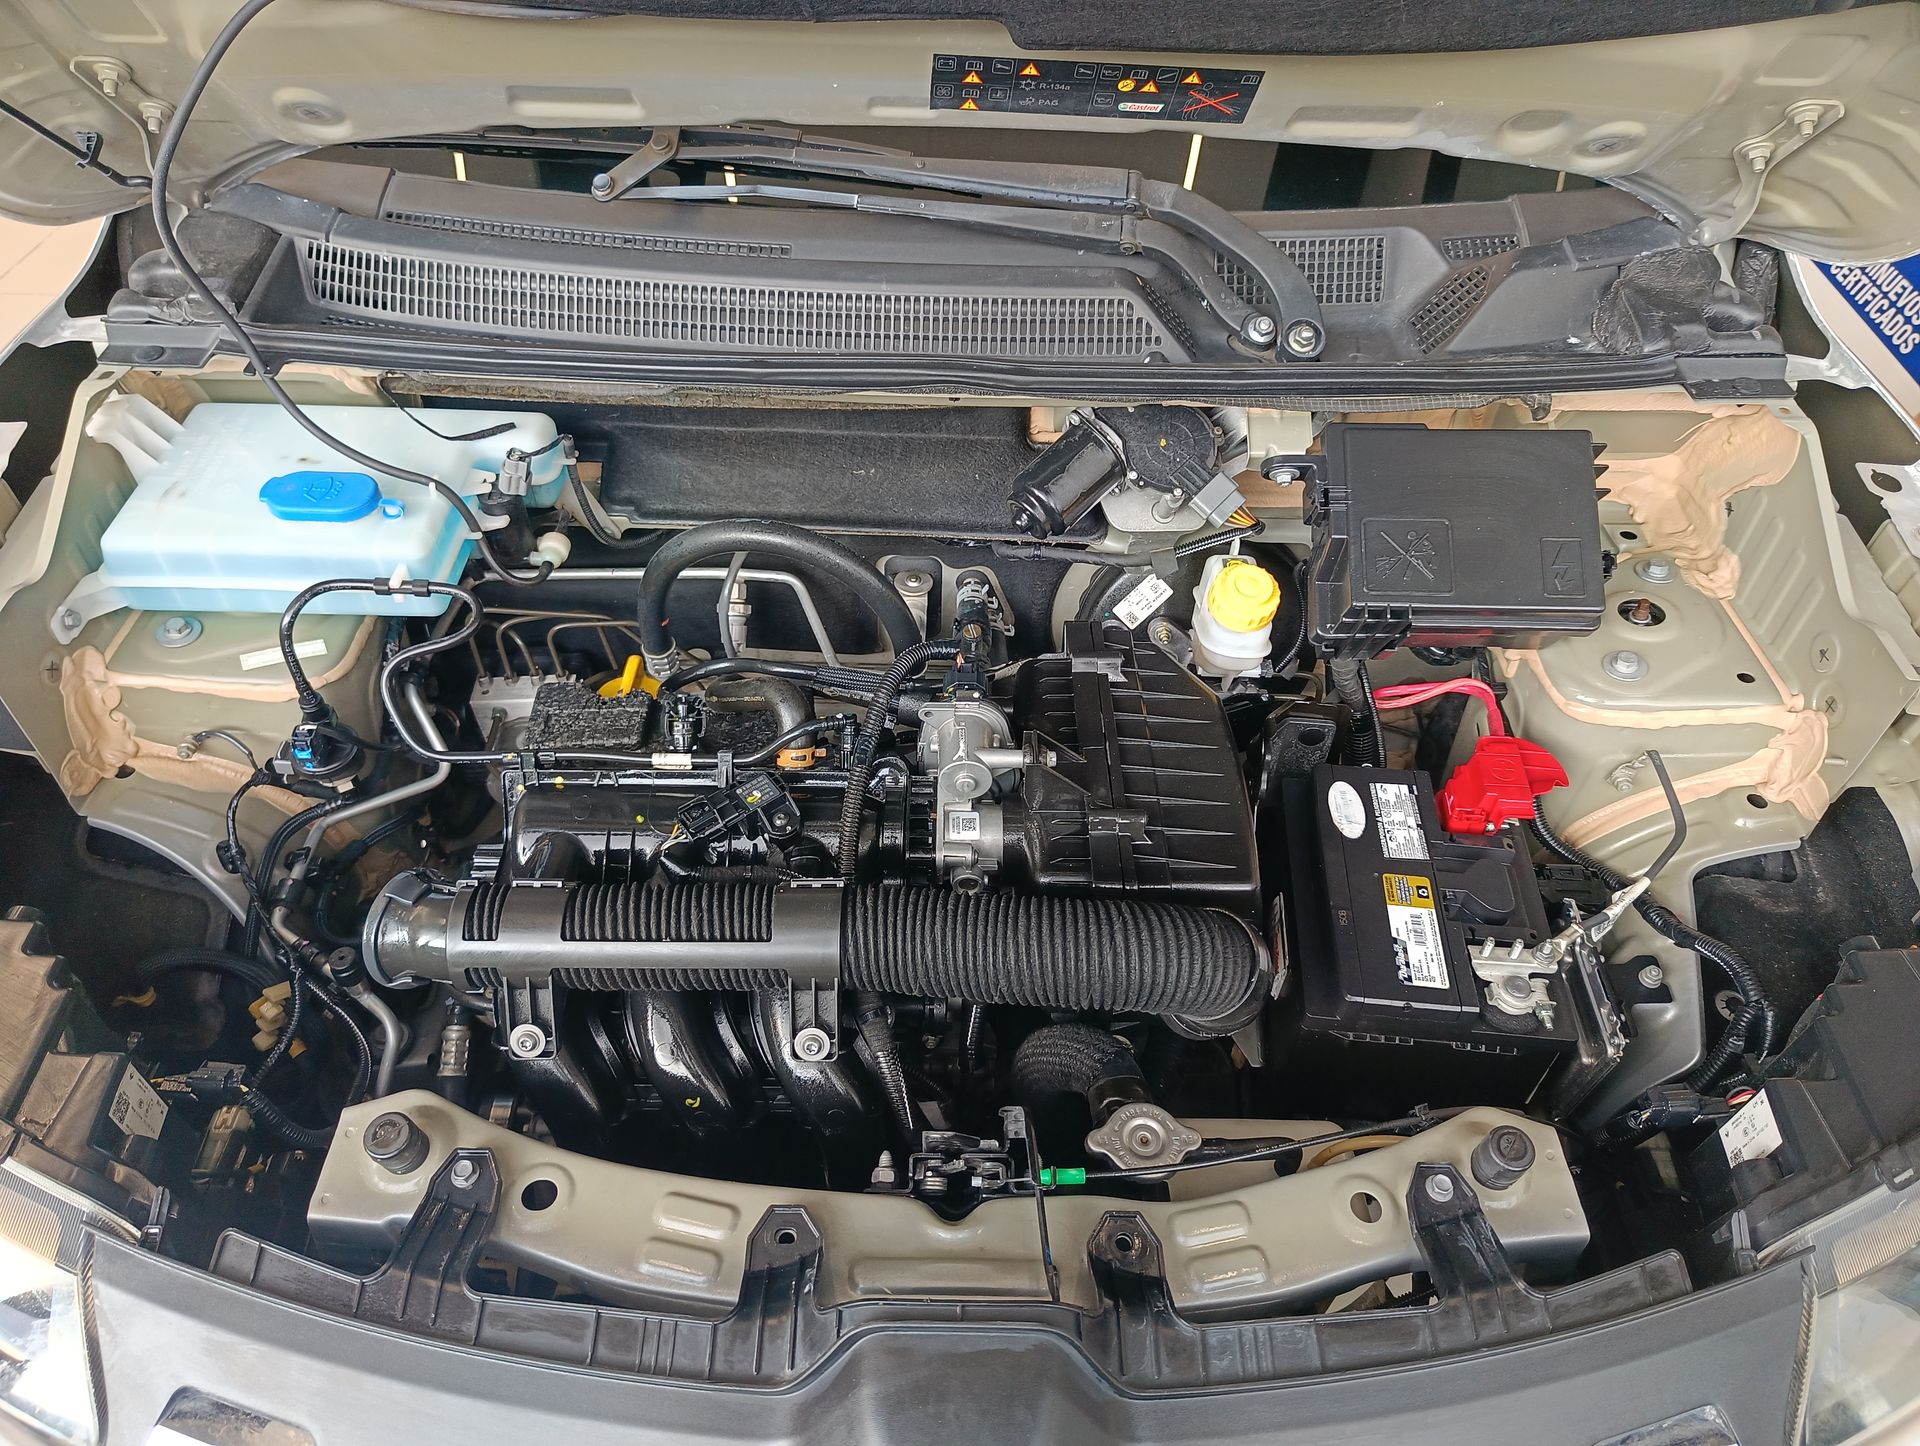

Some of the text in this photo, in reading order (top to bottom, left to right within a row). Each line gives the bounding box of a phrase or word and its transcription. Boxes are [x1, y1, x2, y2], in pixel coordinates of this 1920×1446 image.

[1039, 83, 1070, 91] R-134a
[1128, 104, 1160, 112] Castrol
[1830, 265, 1920, 354] CERTIFICADOS
